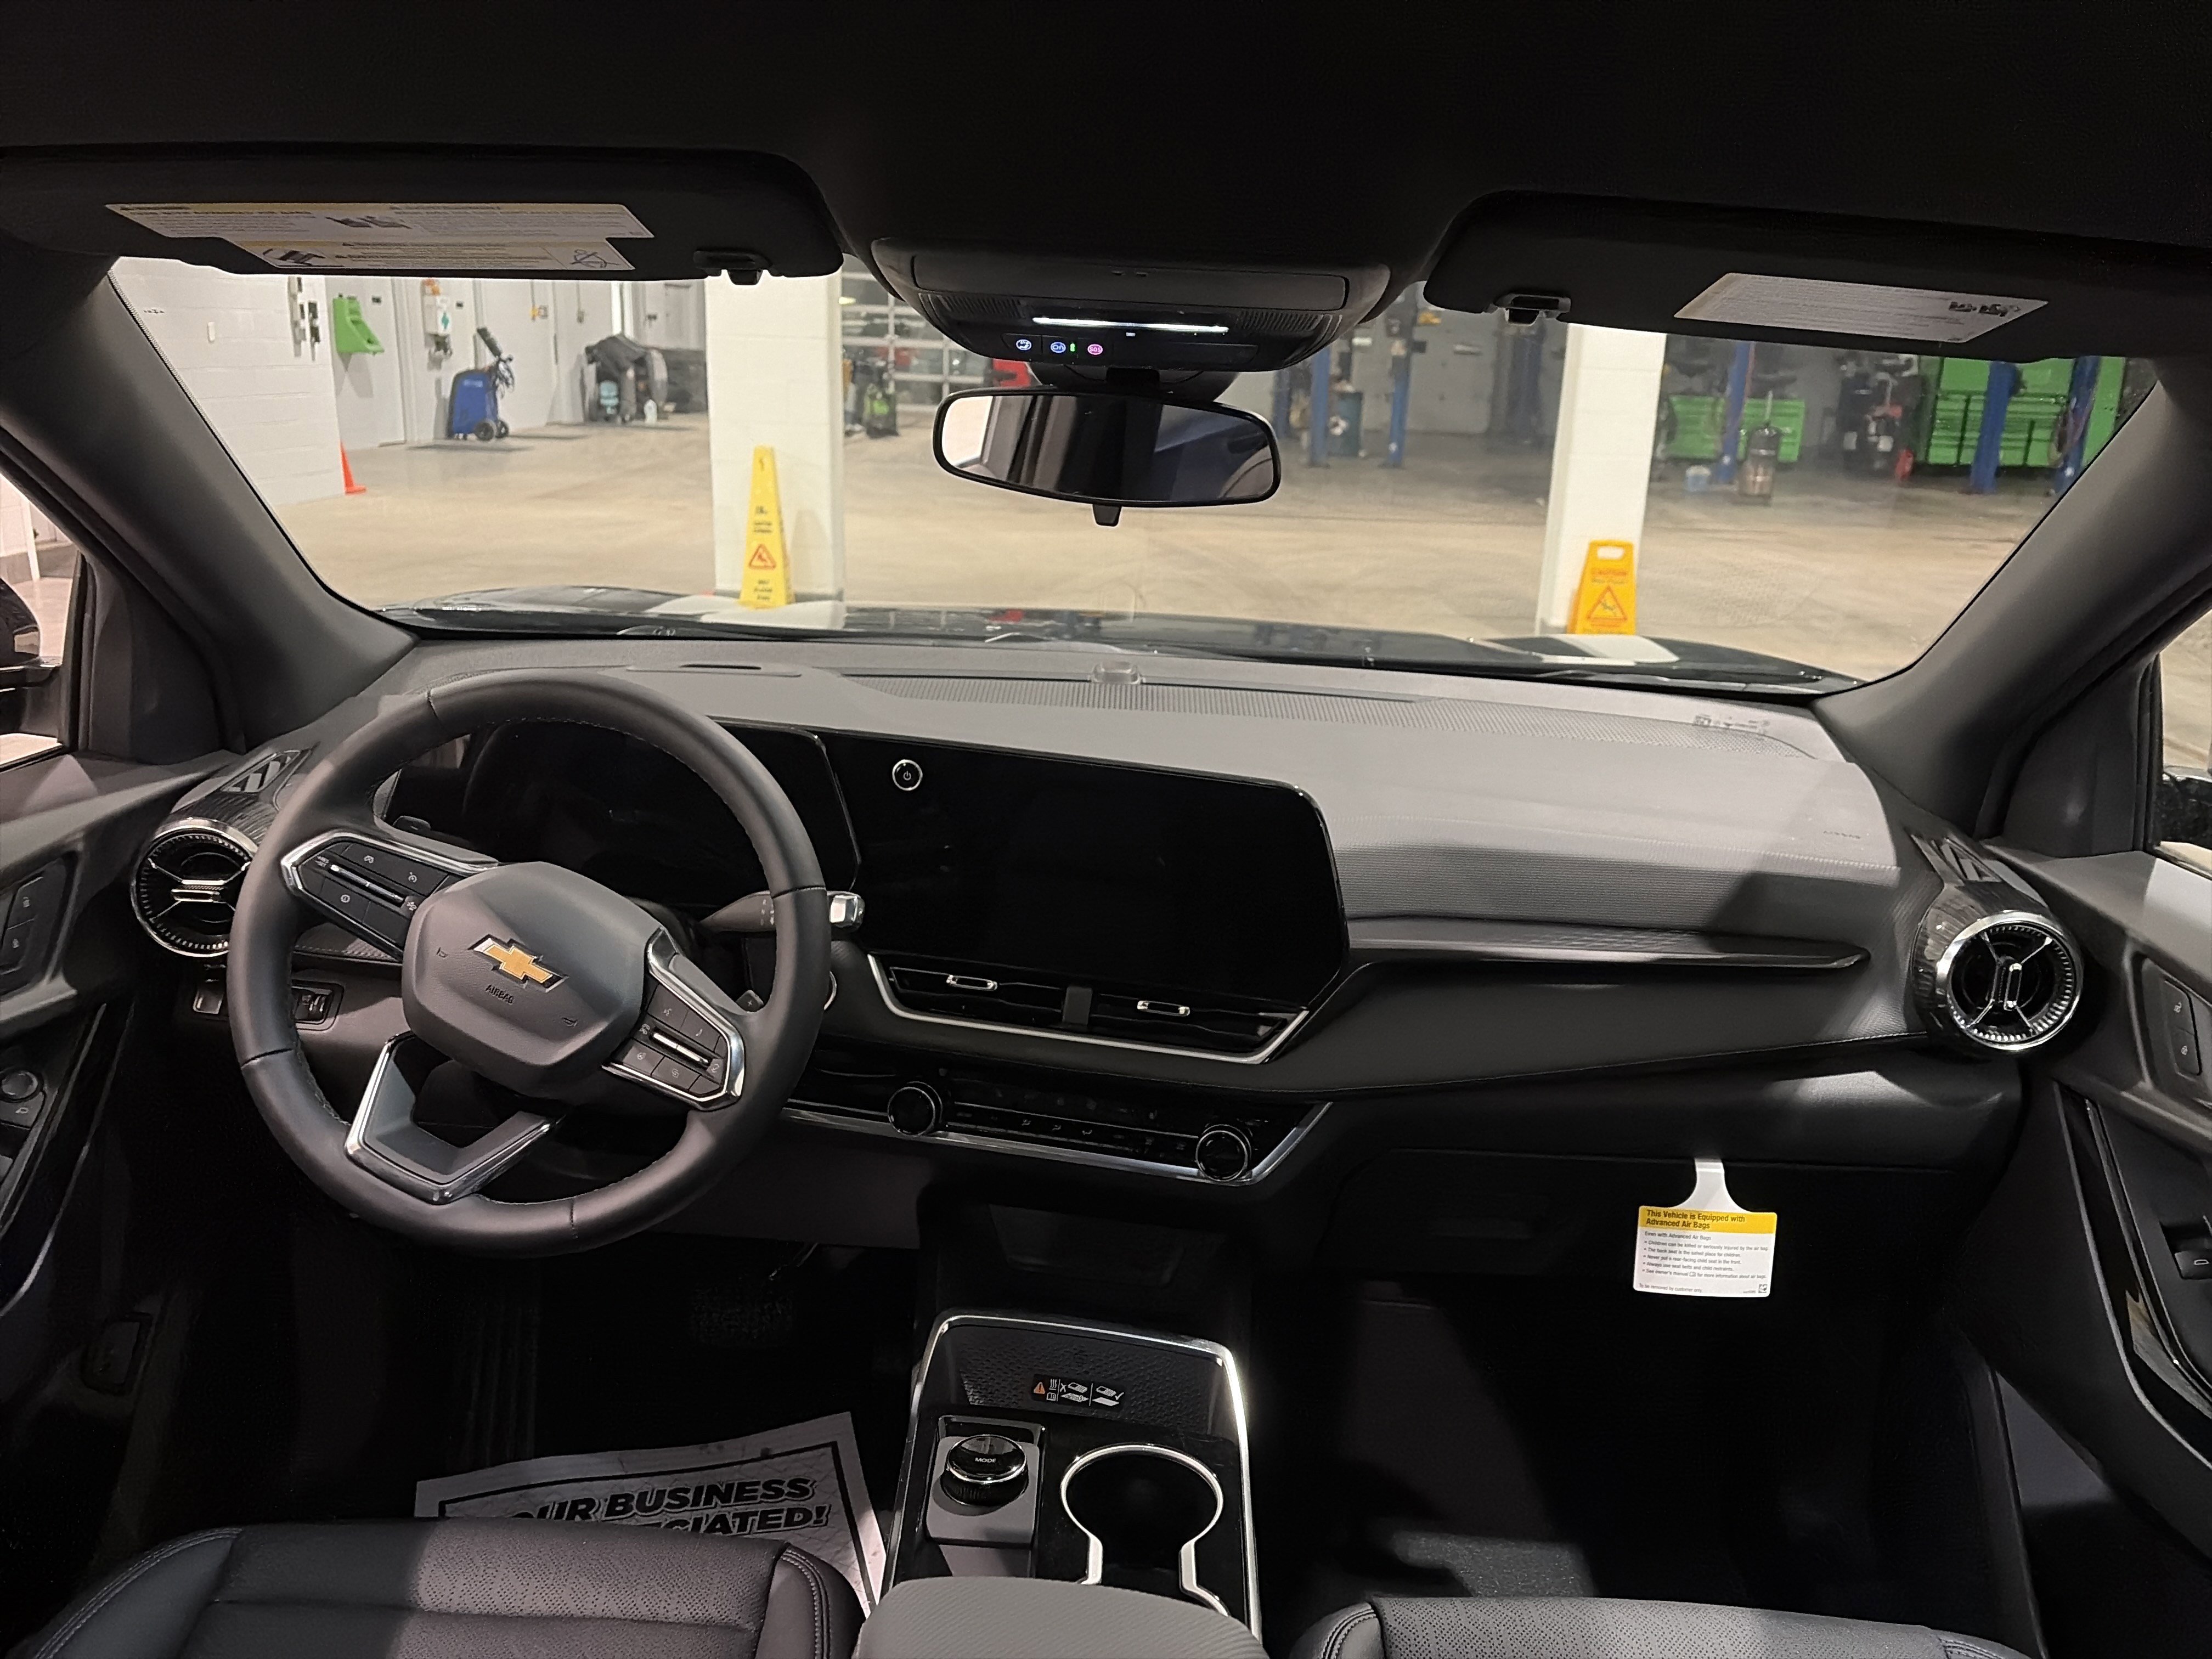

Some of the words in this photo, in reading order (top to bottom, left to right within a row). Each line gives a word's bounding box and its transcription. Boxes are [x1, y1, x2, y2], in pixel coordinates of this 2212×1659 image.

[485, 985, 514, 1003] AIRBAG
[1647, 1209, 1661, 1217] This
[1663, 1210, 1688, 1218] Vehicle
[1697, 1213, 1729, 1222] Equipped
[1646, 1218, 1680, 1227] Advanced
[1694, 1221, 1710, 1230] Bags
[604, 1478, 815, 1519] BUSINESS
